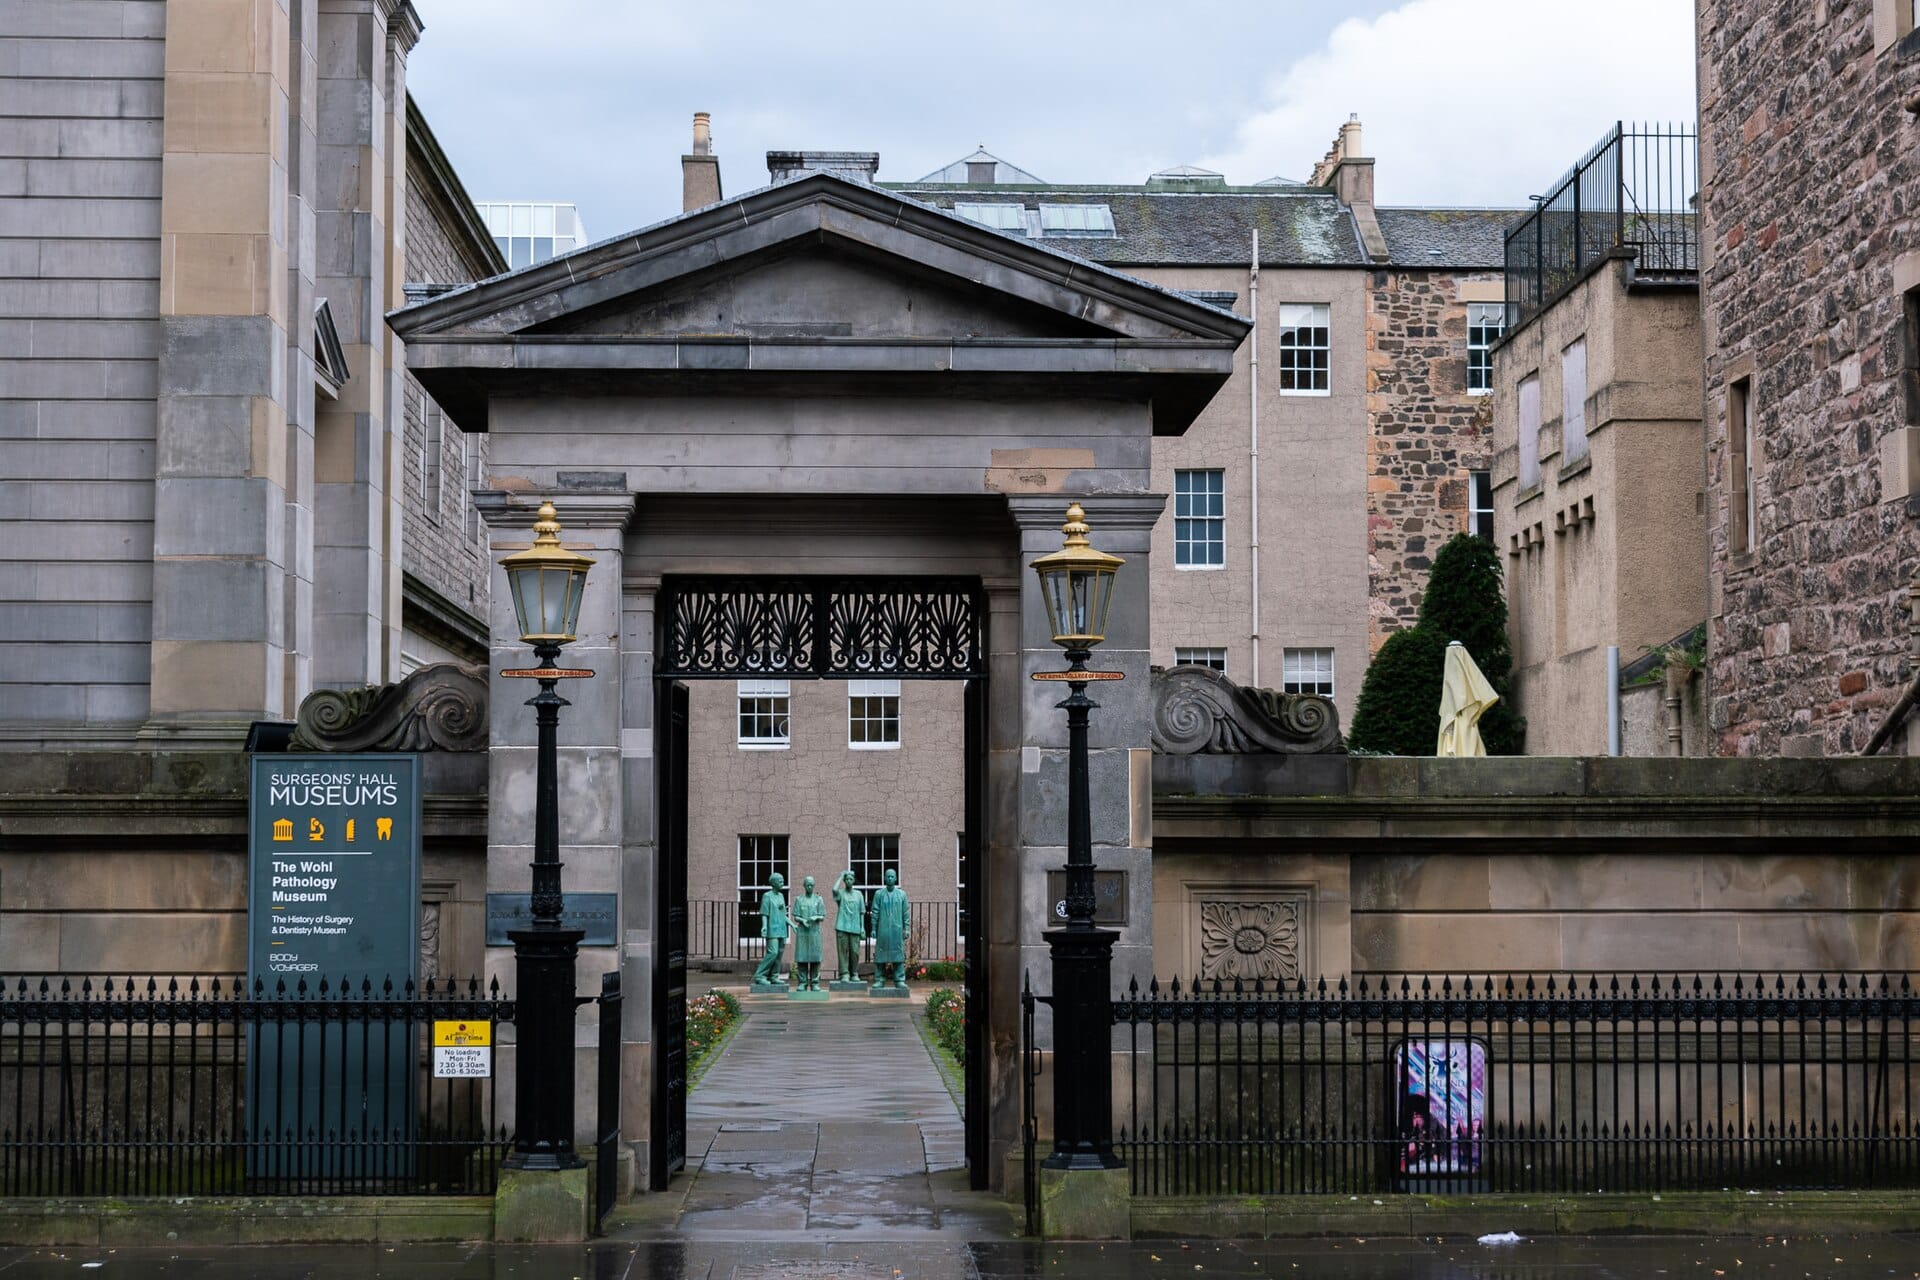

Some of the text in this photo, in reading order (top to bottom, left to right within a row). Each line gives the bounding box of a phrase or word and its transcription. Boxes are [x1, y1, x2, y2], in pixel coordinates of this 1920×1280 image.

[360, 774, 397, 785] HALL
[270, 786, 398, 806] MUSEUMS
[272, 861, 333, 872] The Wohl
[272, 876, 337, 889] Pathology
[272, 891, 328, 902] Museum
[272, 915, 353, 925] The History of Surgery
[272, 926, 347, 936] & Dentistry Museum
[270, 953, 298, 962] BODY
[269, 963, 319, 972] VOYAGER
